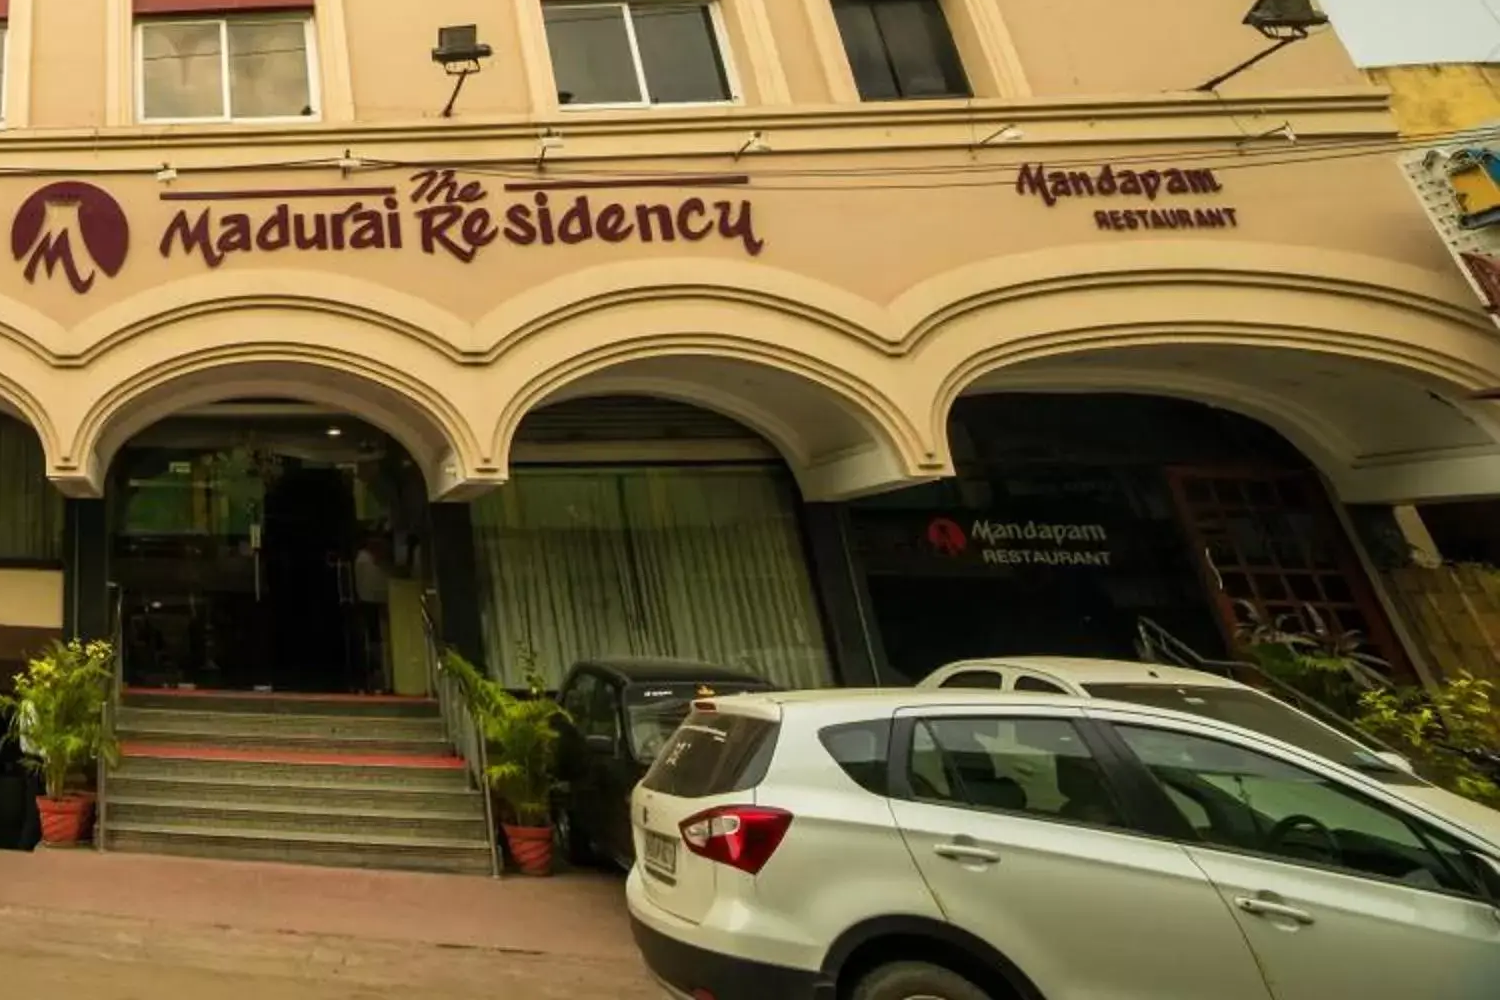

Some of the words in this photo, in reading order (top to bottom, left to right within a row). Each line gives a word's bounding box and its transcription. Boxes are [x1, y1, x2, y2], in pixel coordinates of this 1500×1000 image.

[410, 169, 487, 204] The
[1016, 162, 1223, 207] Mandapam
[159, 192, 402, 268] Madurai
[414, 191, 764, 263] Residency
[1093, 208, 1238, 230] RESTAURANT
[971, 519, 1107, 546] Mandapam
[982, 549, 1111, 566] RESTAURANT
